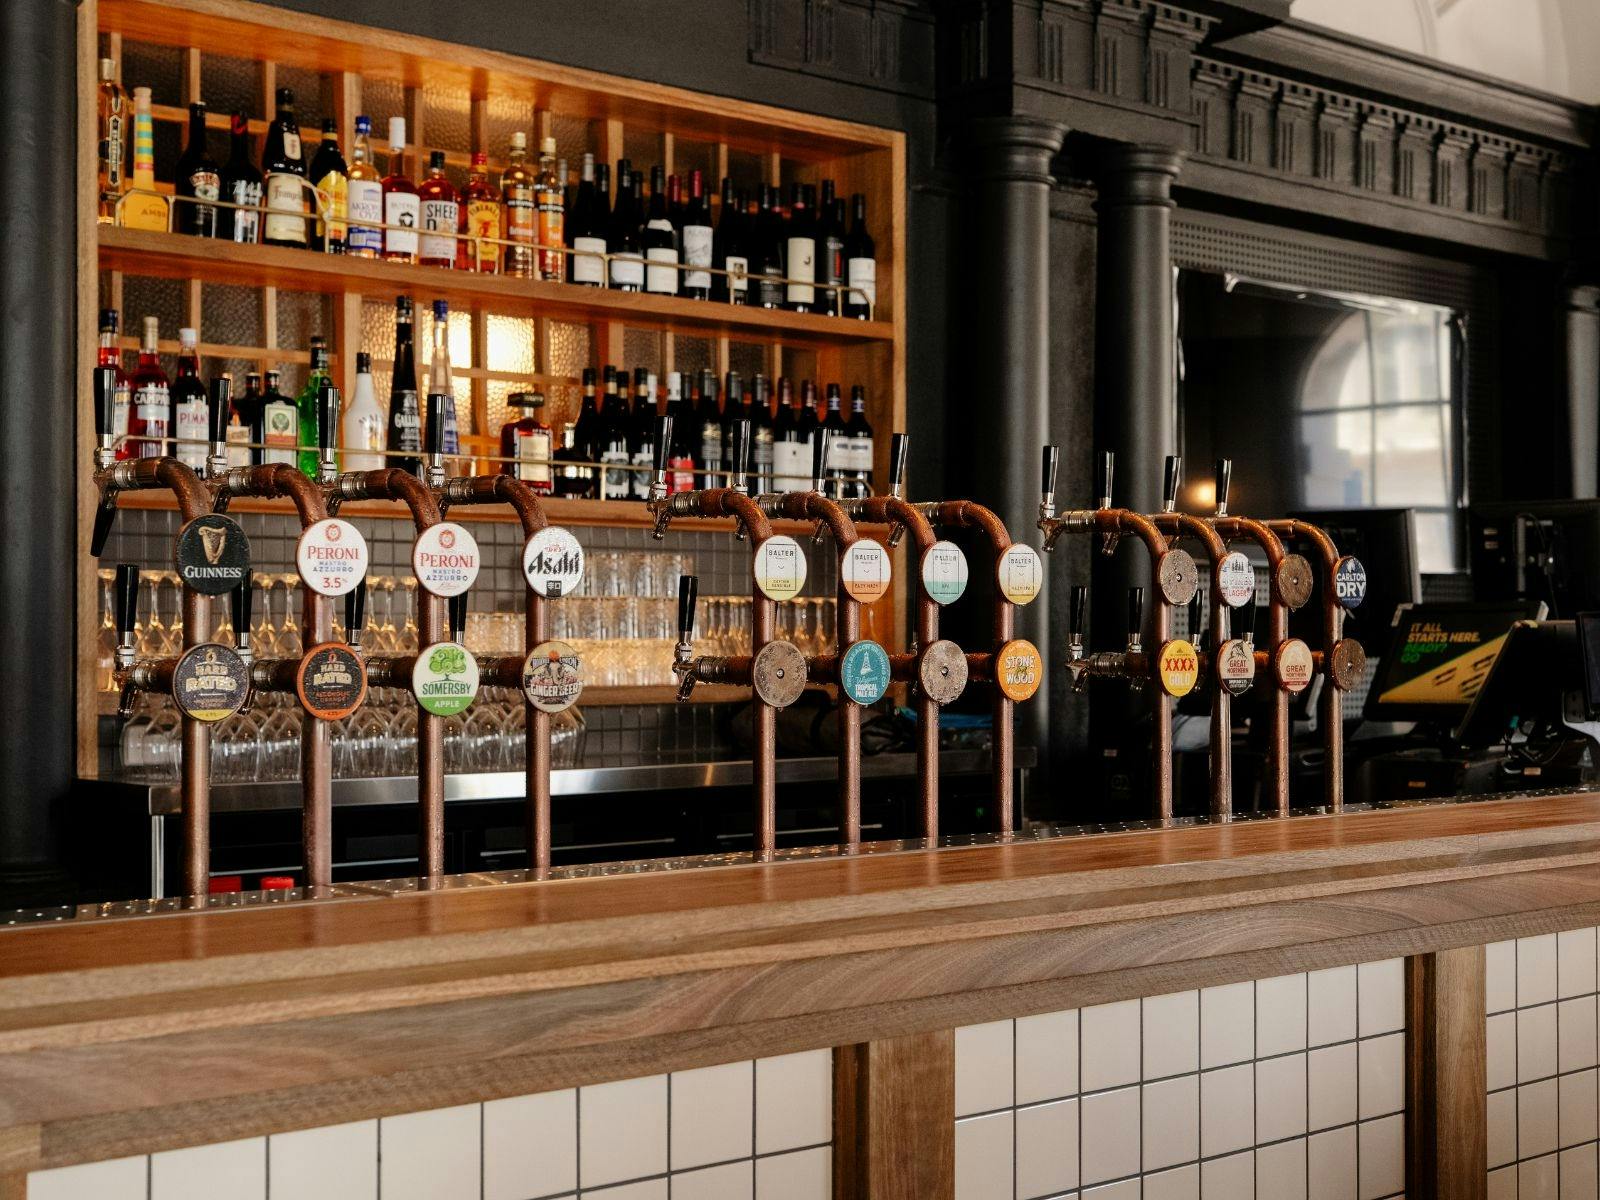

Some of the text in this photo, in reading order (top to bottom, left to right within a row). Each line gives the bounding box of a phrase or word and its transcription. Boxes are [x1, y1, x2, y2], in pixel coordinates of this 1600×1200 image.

[307, 545, 360, 560] PERONI
[768, 549, 794, 557] BALTER
[420, 552, 474, 568] PERONI
[528, 550, 580, 575] Asahi
[183, 565, 243, 579] GUINNESS
[1336, 572, 1365, 581] CARLTON
[1336, 581, 1366, 598] DRY
[1411, 623, 1442, 632] IT ALL
[1408, 632, 1481, 643] STARTS HERE.
[320, 663, 346, 672] HARD
[1006, 656, 1035, 669] STONE
[1165, 658, 1195, 671] XXXX
[1229, 660, 1246, 668] GREAT
[196, 663, 229, 676] HARD
[185, 675, 237, 692] RATED
[313, 671, 352, 686] RATED
[1006, 671, 1035, 685] WOOD
[1168, 673, 1191, 687] GOLD
[422, 682, 471, 695] SOMERSBY
[530, 682, 558, 697] GINGER
[434, 700, 461, 708] APPLE
